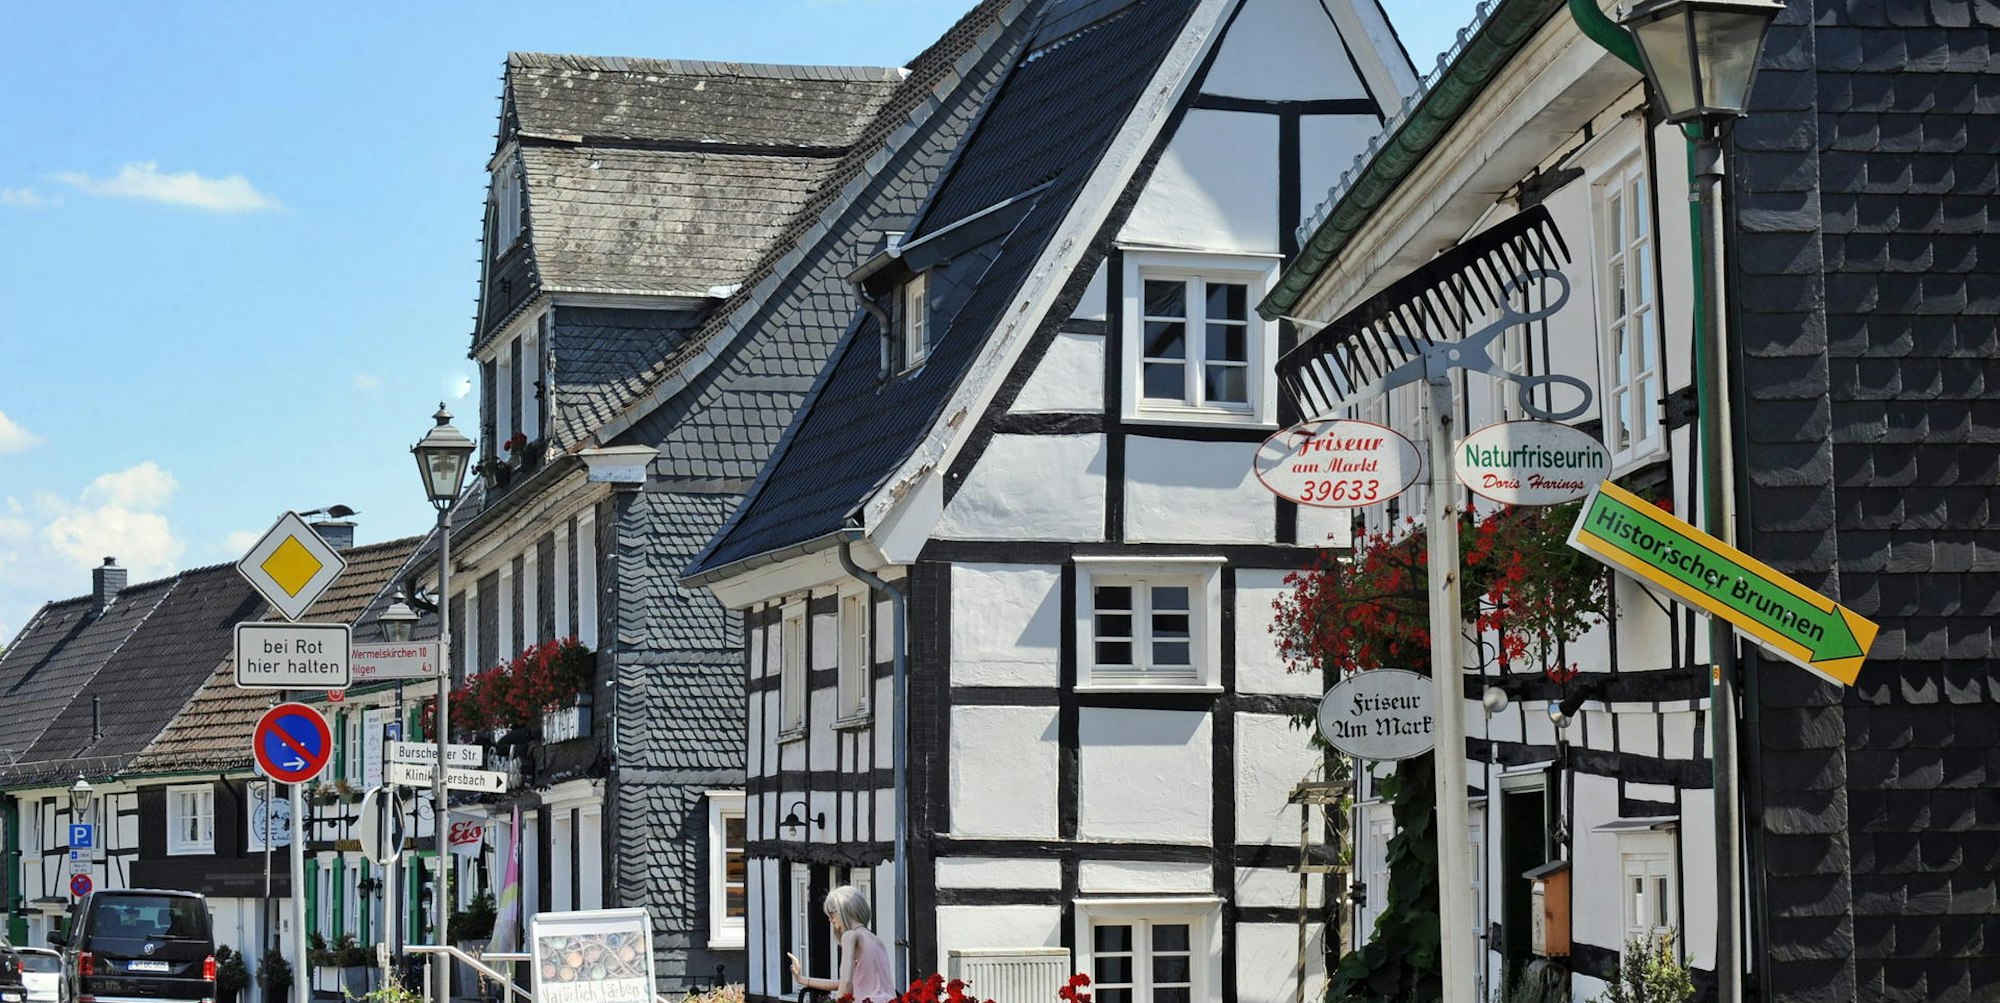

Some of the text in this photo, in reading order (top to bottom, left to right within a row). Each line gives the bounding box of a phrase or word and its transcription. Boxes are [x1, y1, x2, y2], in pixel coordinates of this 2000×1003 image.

[1288, 431, 1383, 456] Friseur
[1292, 457, 1378, 473] am Markt
[1465, 443, 1603, 469] Naturfriseurin
[1300, 479, 1379, 501] 39633
[1482, 473, 1585, 494] Doris Harings
[1596, 505, 1826, 643] Historischer Brunnen
[263, 639, 323, 654] bei Rot
[419, 647, 427, 658] 10
[247, 658, 339, 674] hier halten
[1350, 693, 1421, 716] Friseur
[1332, 715, 1433, 738] Am Mark
[462, 748, 478, 761] Str.
[447, 773, 486, 787] ersbach
[448, 820, 482, 844] Eis
